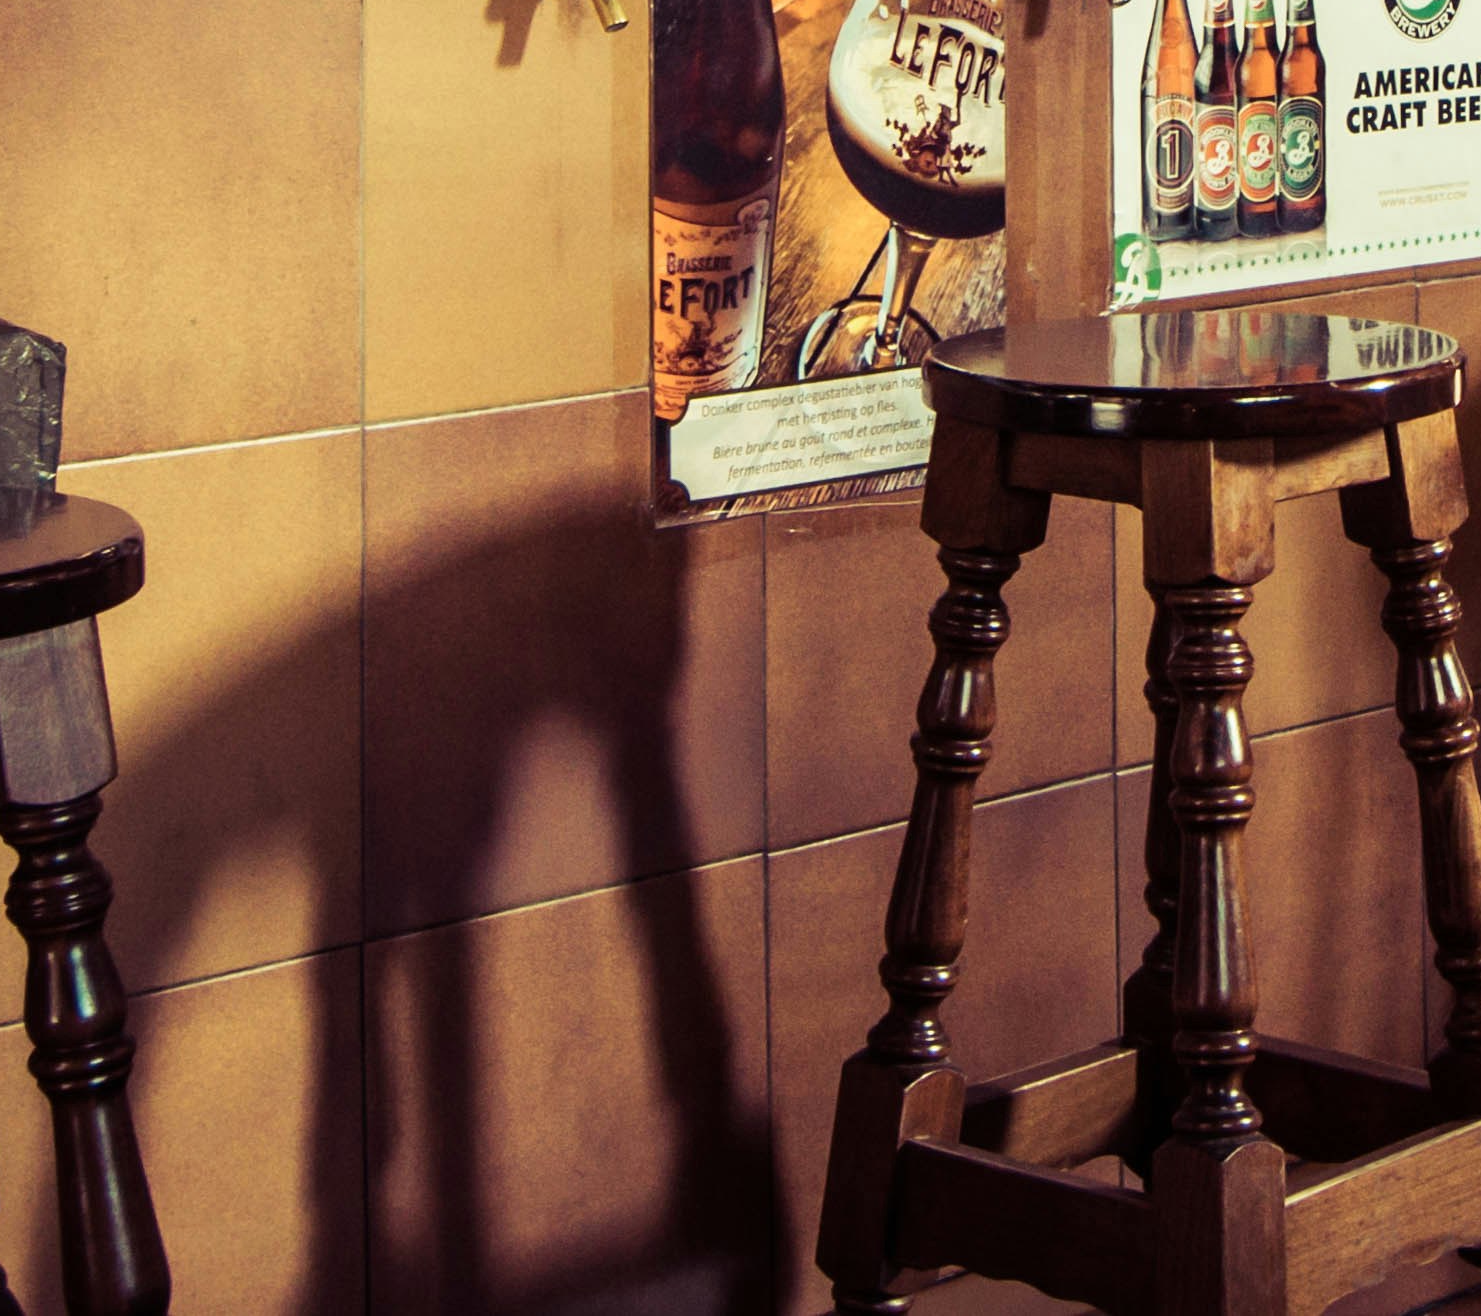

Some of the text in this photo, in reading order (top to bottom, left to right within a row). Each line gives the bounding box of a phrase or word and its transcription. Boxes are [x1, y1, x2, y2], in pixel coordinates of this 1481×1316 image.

[1388, 6, 1457, 41] BREWERY
[1346, 99, 1427, 135] CRAFT
[745, 394, 795, 415] complex
[878, 378, 899, 393] van
[776, 412, 800, 429] met
[859, 405, 875, 418] op
[828, 427, 854, 442] rond
[855, 425, 869, 437] et
[878, 444, 894, 456] en
